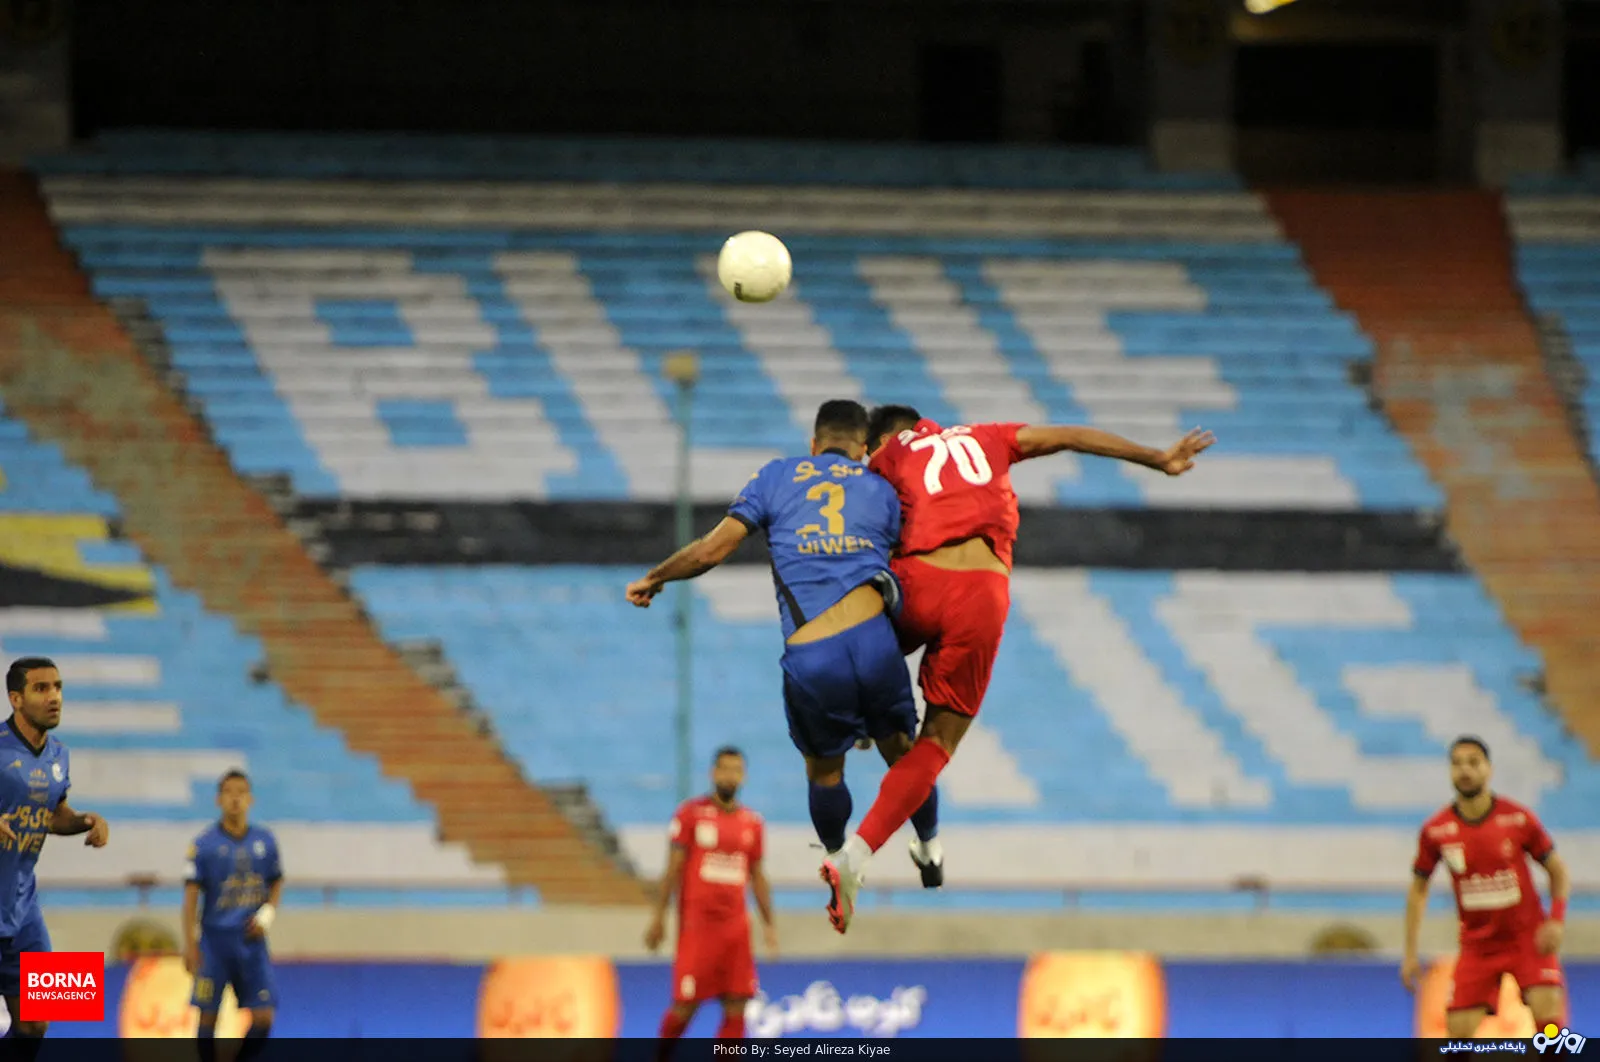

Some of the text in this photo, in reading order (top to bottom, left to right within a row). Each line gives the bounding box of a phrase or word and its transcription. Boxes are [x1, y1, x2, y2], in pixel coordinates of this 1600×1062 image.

[205, 247, 1358, 510] BLUE
[909, 432, 992, 495] 70
[805, 481, 846, 536] 3
